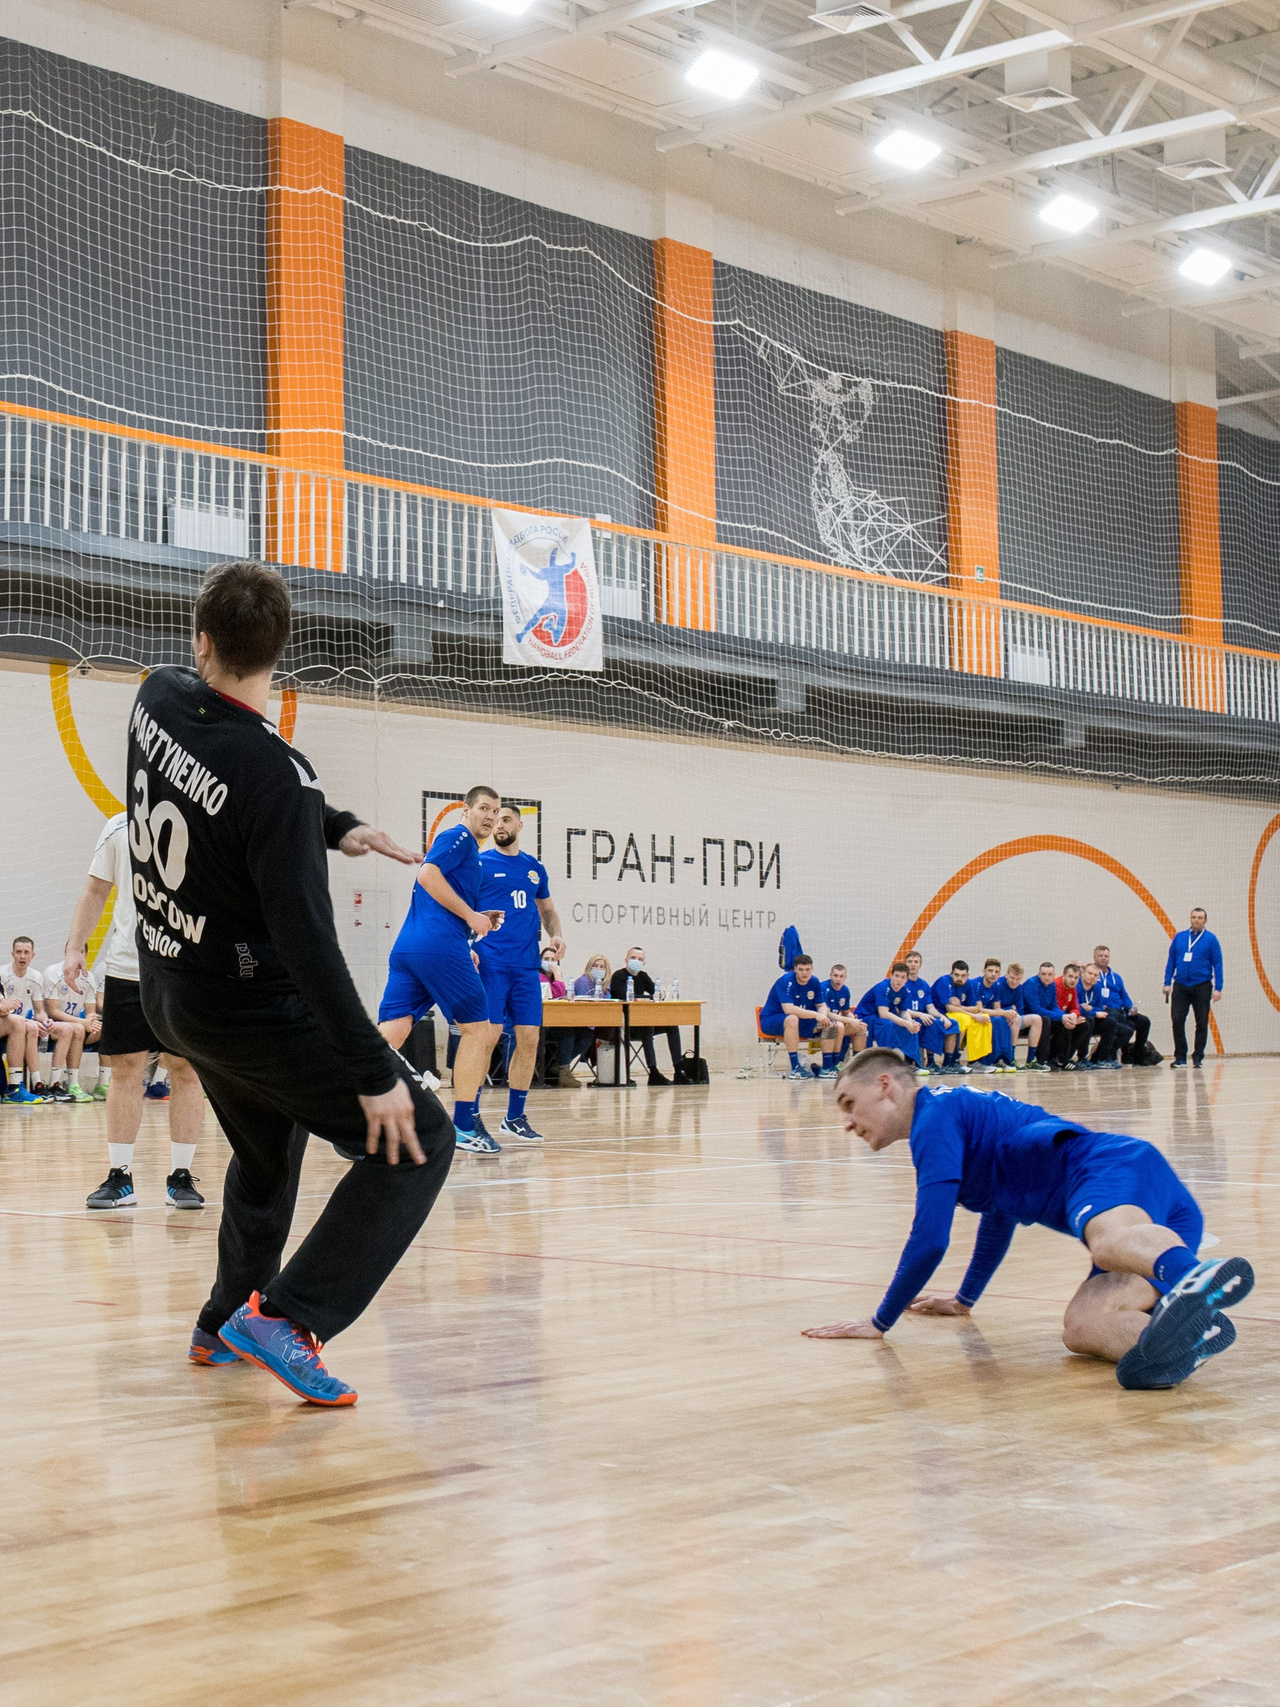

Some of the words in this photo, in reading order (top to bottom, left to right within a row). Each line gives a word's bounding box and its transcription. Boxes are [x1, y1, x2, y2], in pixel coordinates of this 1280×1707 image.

[528, 636, 564, 661] HANDBALL
[563, 616, 595, 659] FEDERATION
[129, 701, 229, 817] MARTYNENKO
[128, 768, 189, 892] 30
[566, 827, 781, 890] ГРАН-ПРИ
[133, 872, 207, 945] OSCOW
[510, 889, 527, 909] 10
[572, 901, 709, 927] СПОРТИВНЫЙ
[718, 908, 777, 932] ЦЕНТР
[64, 1001, 78, 1016] 27
